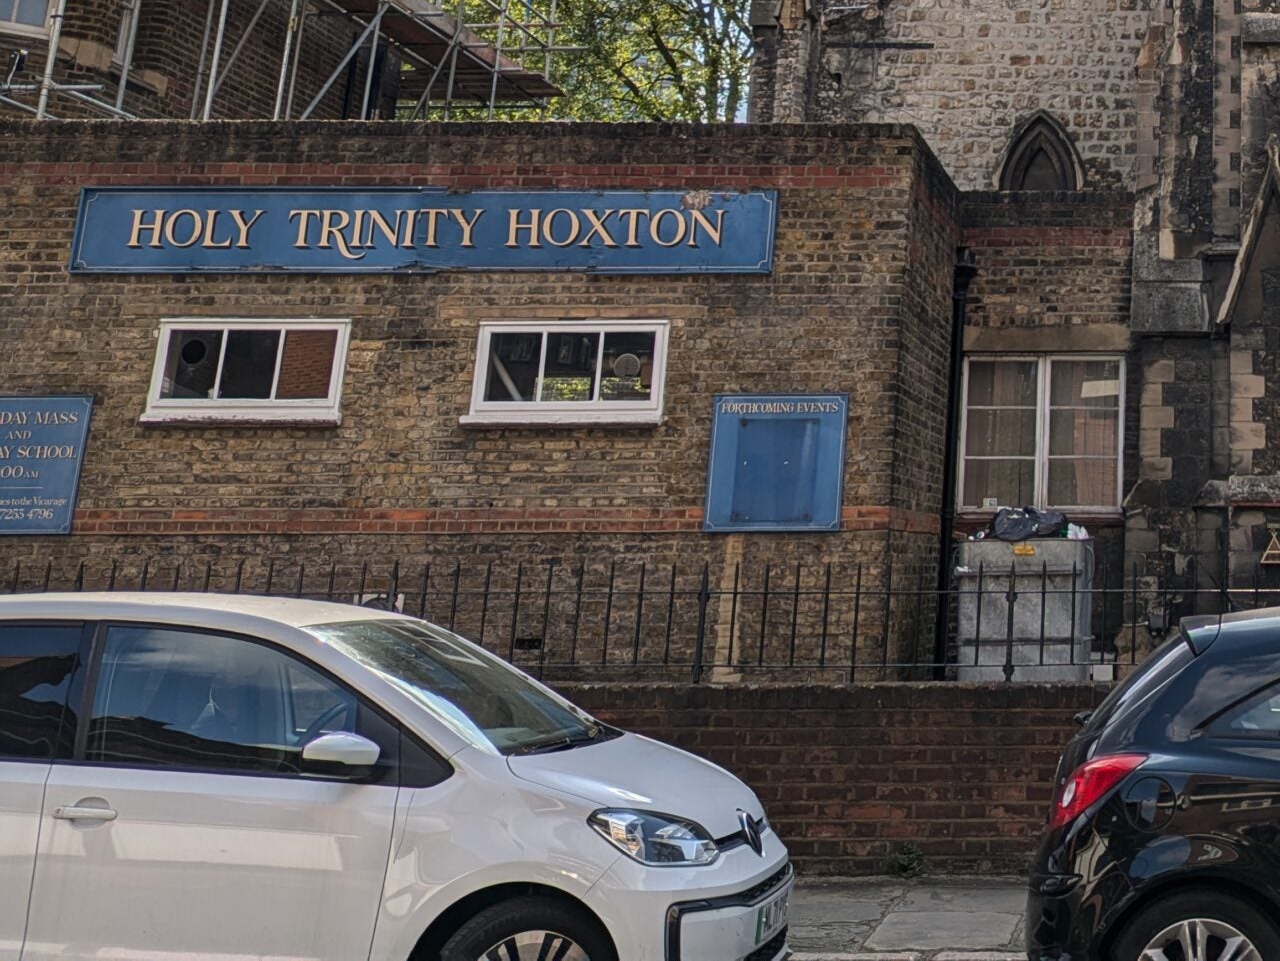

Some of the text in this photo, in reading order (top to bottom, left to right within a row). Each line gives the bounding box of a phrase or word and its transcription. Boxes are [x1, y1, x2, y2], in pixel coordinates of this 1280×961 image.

[126, 207, 729, 259] HOLY TRINITY HOXTON
[722, 402, 839, 414] FORTHCOMING EVENTS
[34, 411, 78, 425] MASS
[5, 430, 31, 439] AND
[17, 445, 77, 459] SCHOOL
[33, 496, 67, 507] Vicarage
[27, 508, 53, 519] 4796
